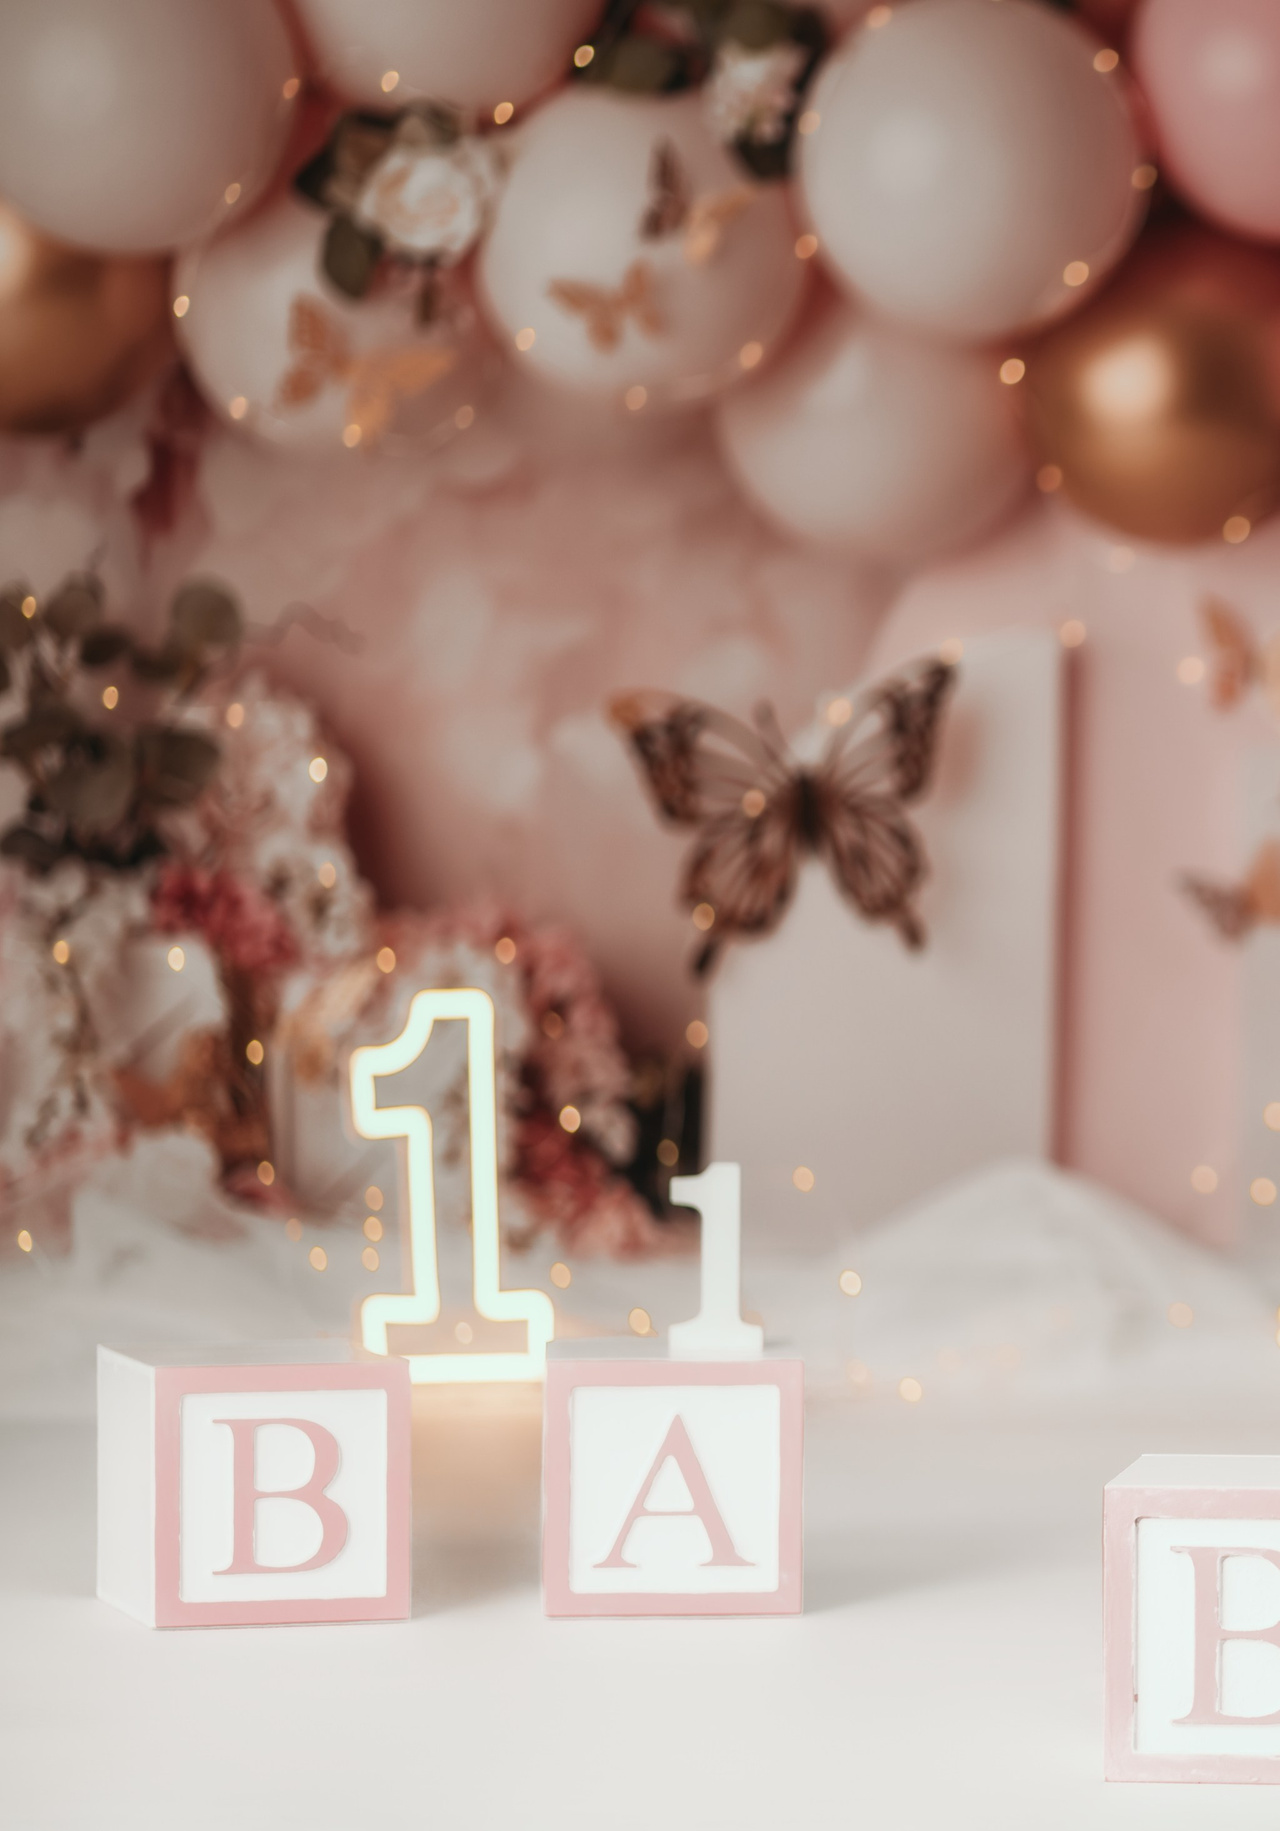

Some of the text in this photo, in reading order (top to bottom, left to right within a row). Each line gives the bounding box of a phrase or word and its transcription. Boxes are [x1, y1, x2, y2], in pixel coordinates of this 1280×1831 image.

[351, 988, 554, 1383] 1
[669, 1161, 763, 1359] 1
[212, 1417, 349, 1576] B
[592, 1414, 757, 1569] A
